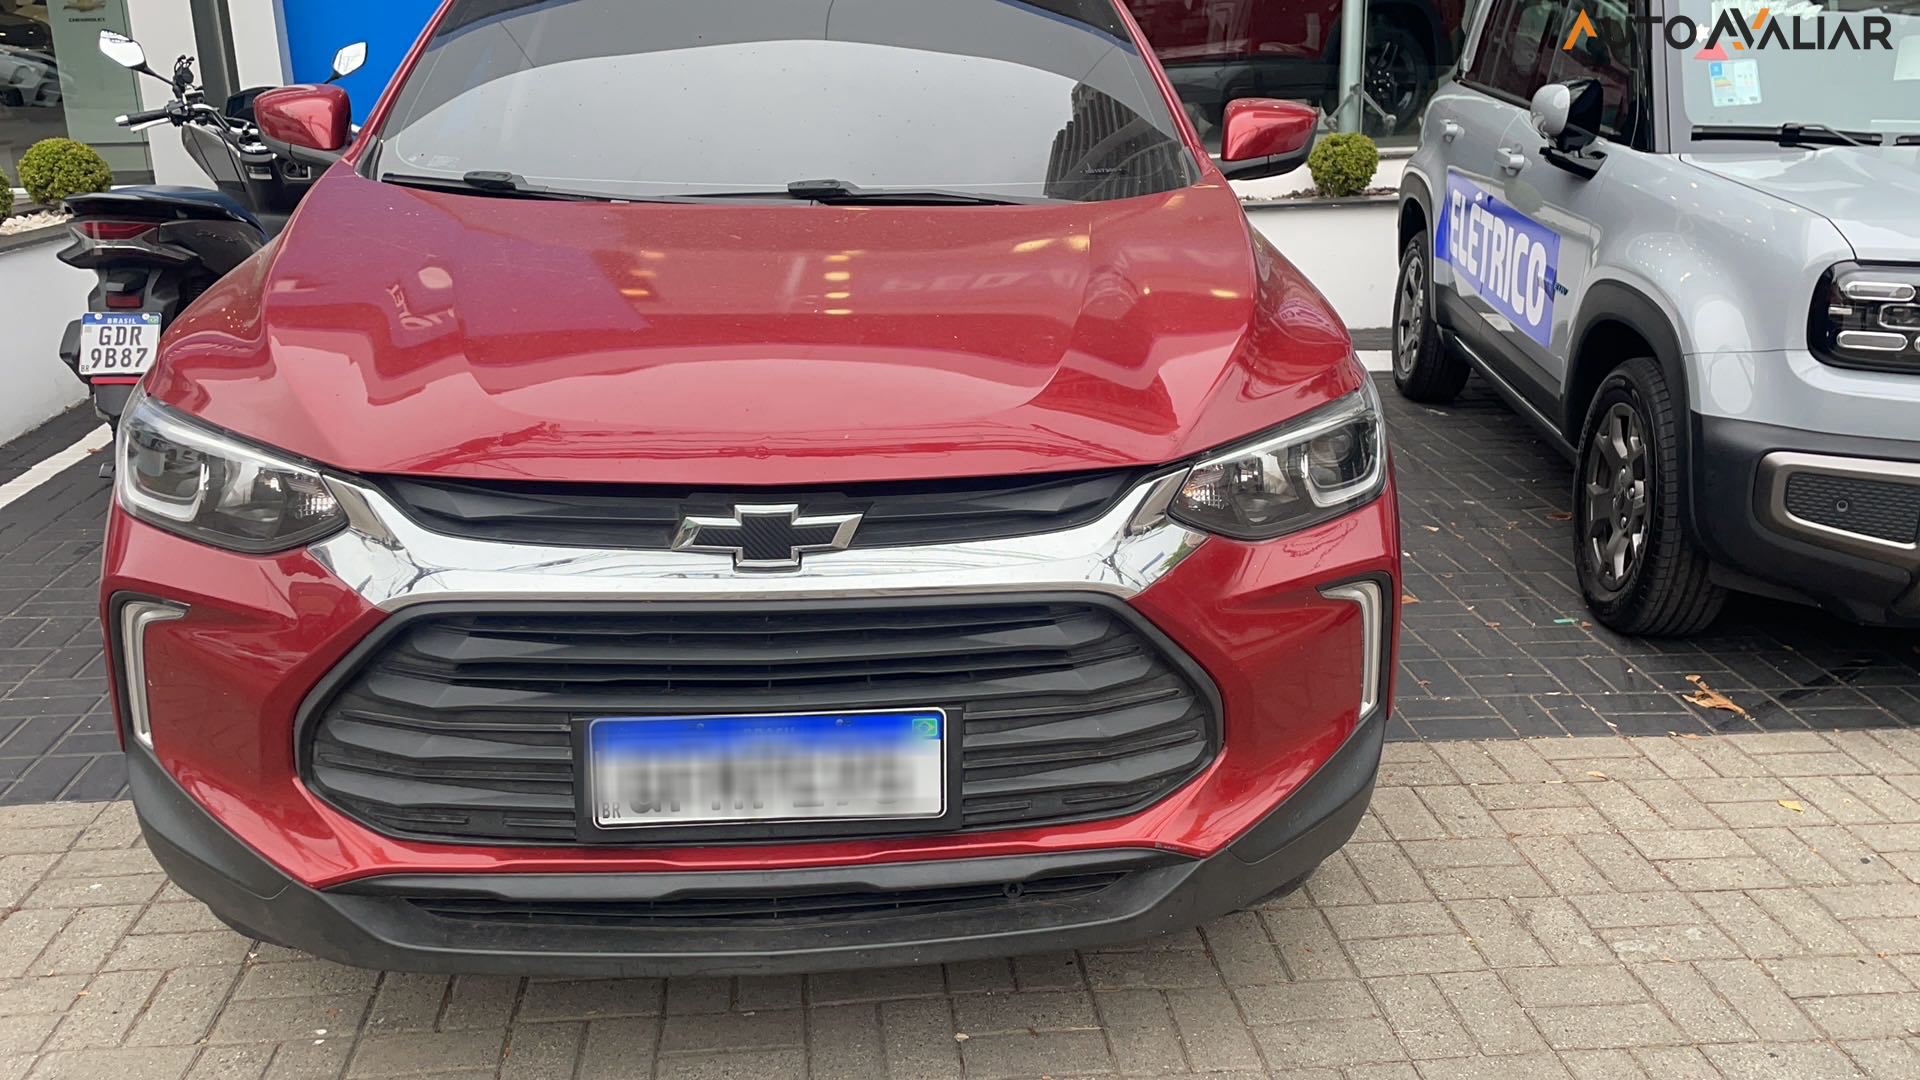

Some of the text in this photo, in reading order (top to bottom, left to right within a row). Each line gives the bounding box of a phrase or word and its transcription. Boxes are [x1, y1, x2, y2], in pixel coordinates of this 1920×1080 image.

[1450, 189, 1548, 327] ELÉTRICO
[106, 317, 137, 325] BRASIL
[98, 326, 142, 346] GDR
[90, 347, 149, 369] 9B87
[602, 801, 621, 819] BR
